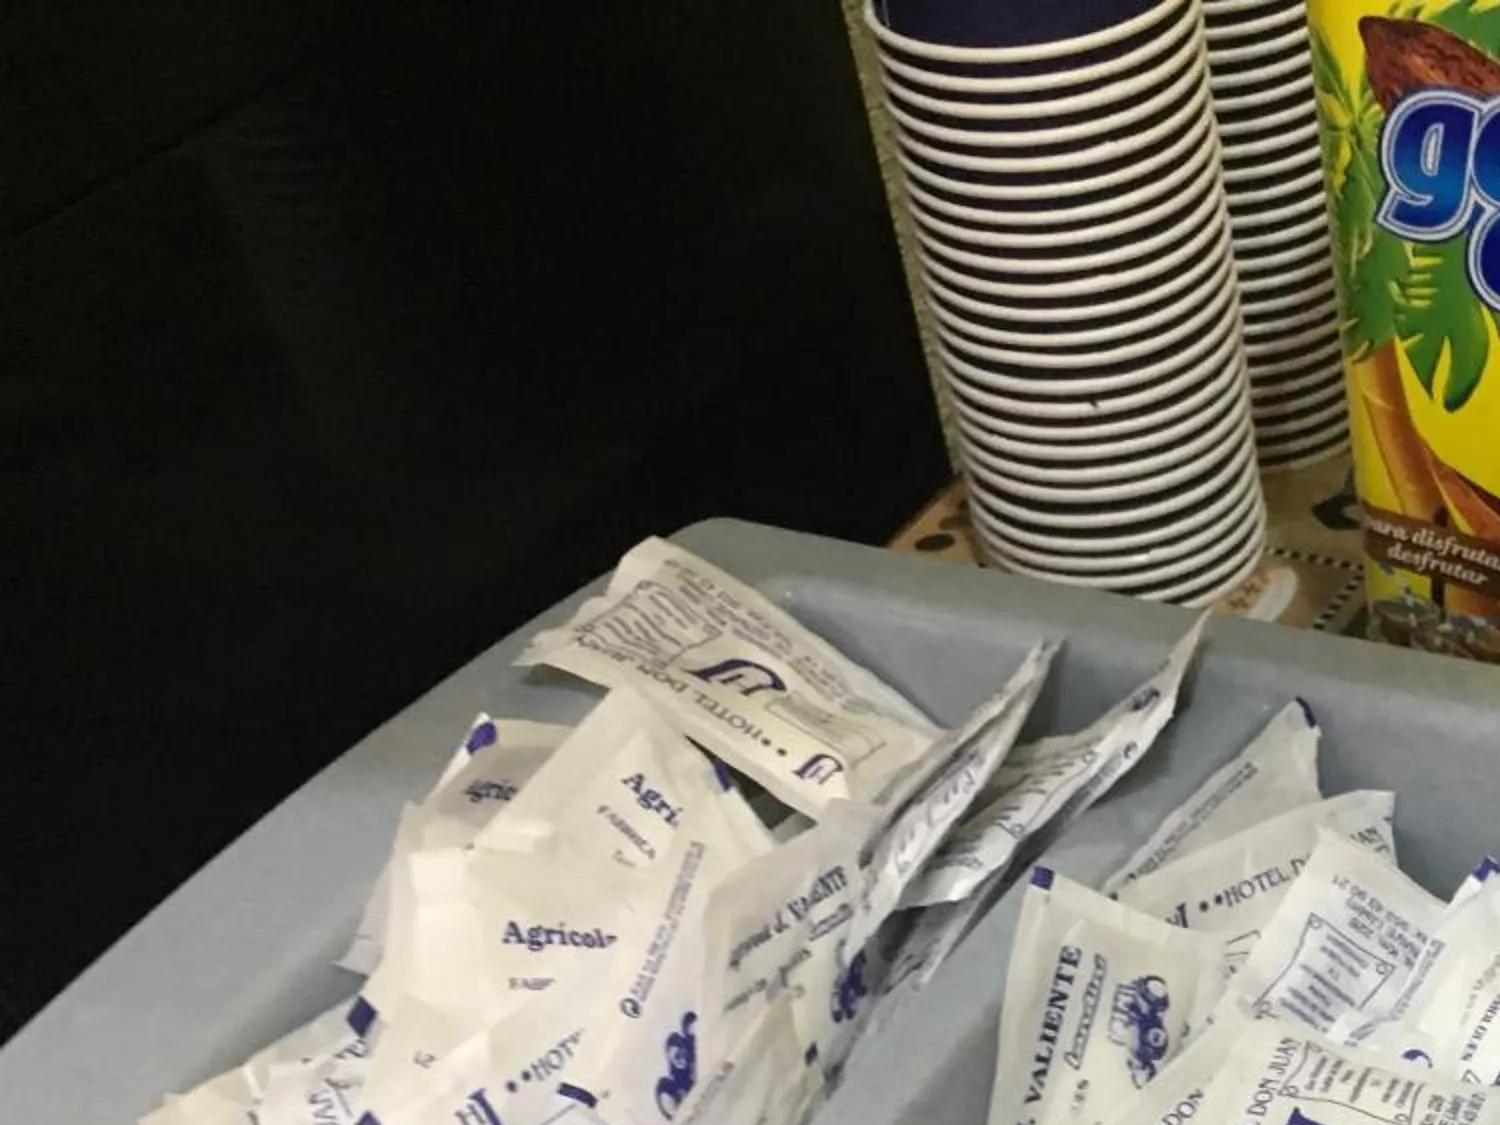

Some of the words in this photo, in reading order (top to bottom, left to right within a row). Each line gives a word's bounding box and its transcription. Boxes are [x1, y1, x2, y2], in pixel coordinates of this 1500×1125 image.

[1387, 543, 1490, 585] desfrutar
[693, 690, 763, 741] HOTEL
[1223, 866, 1288, 908] HOTEL
[1023, 944, 1083, 1106] VALIENTE
[1247, 1077, 1279, 1118] DON
[1267, 1036, 1302, 1076] JUAN
